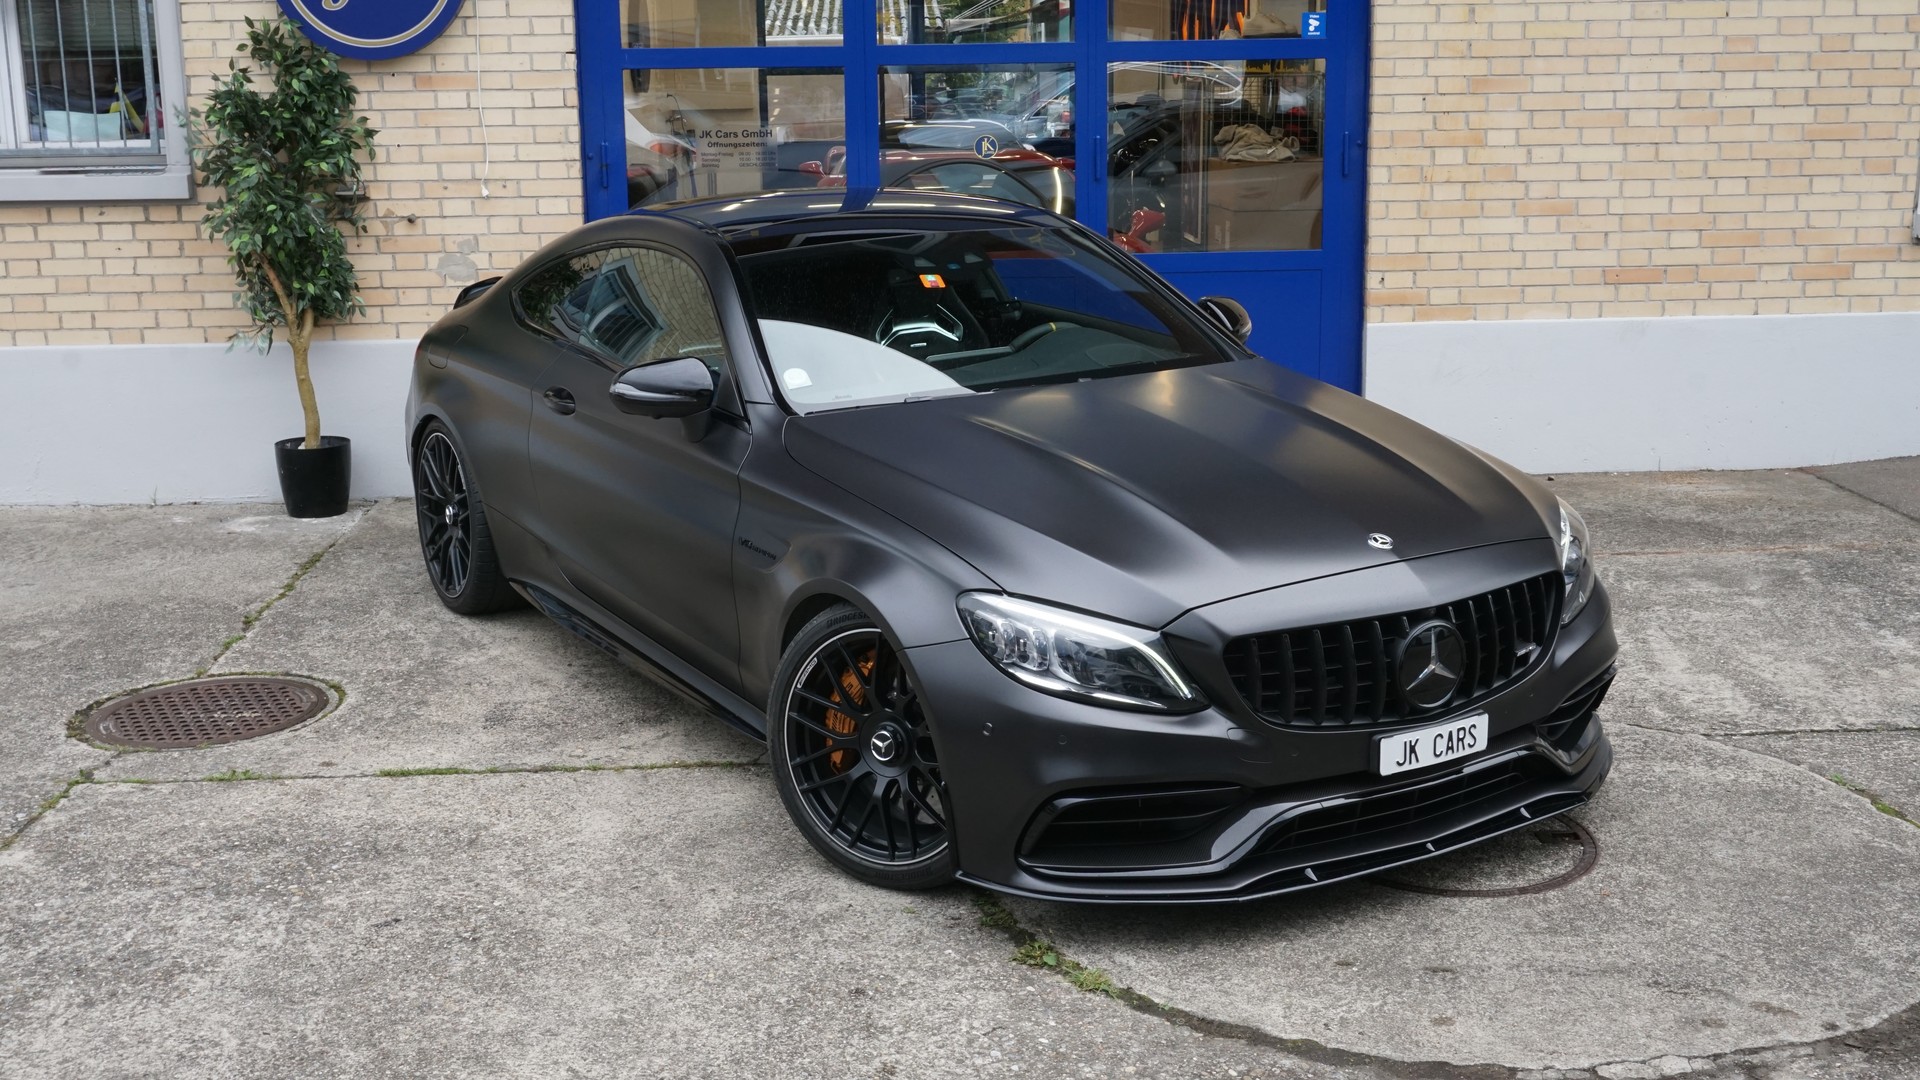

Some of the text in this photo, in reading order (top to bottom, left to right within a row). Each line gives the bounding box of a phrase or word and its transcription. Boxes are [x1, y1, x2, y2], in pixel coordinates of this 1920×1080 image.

[699, 129, 773, 139] JK Cars GmbH
[707, 141, 768, 149] Öffnungszeiten:
[1396, 723, 1478, 767] JK CARS
